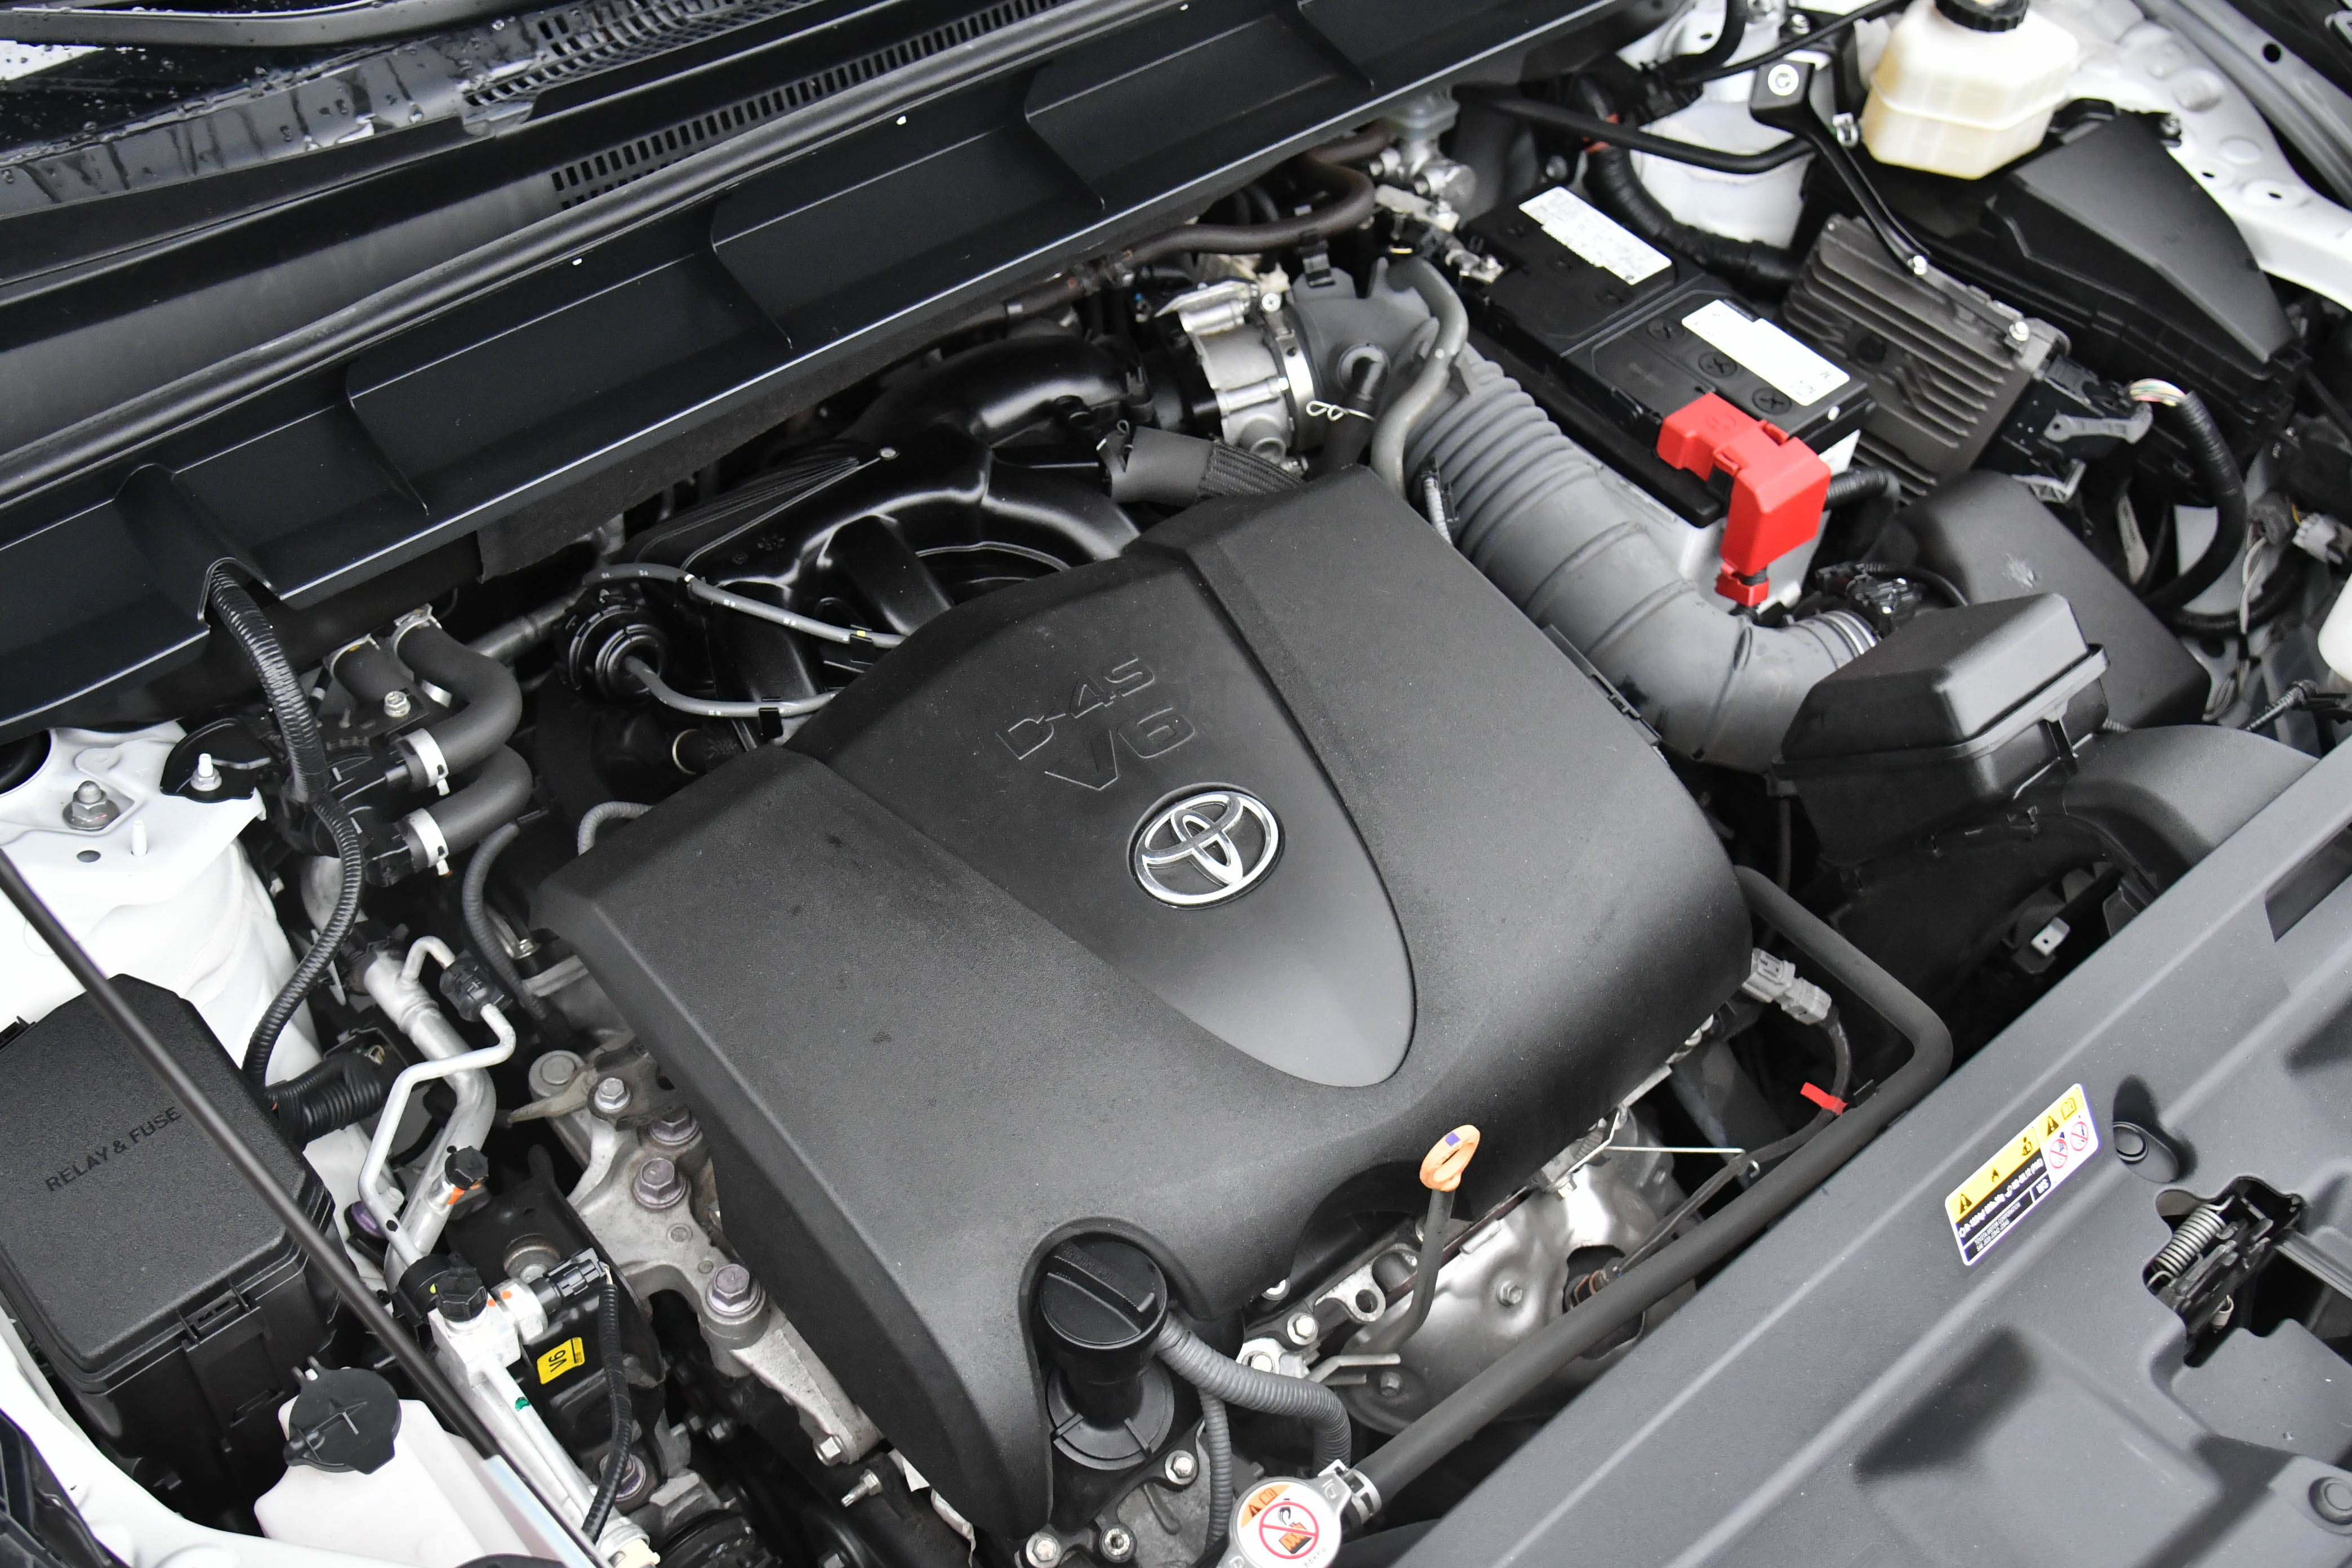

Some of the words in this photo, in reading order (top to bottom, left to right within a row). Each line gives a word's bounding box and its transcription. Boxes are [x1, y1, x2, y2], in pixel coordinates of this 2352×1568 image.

[1044, 707, 1196, 791] V6
[45, 1147, 109, 1192] RELAY
[113, 1139, 128, 1155] &
[129, 1106, 182, 1144] FUSE
[548, 1349, 567, 1373] V6
